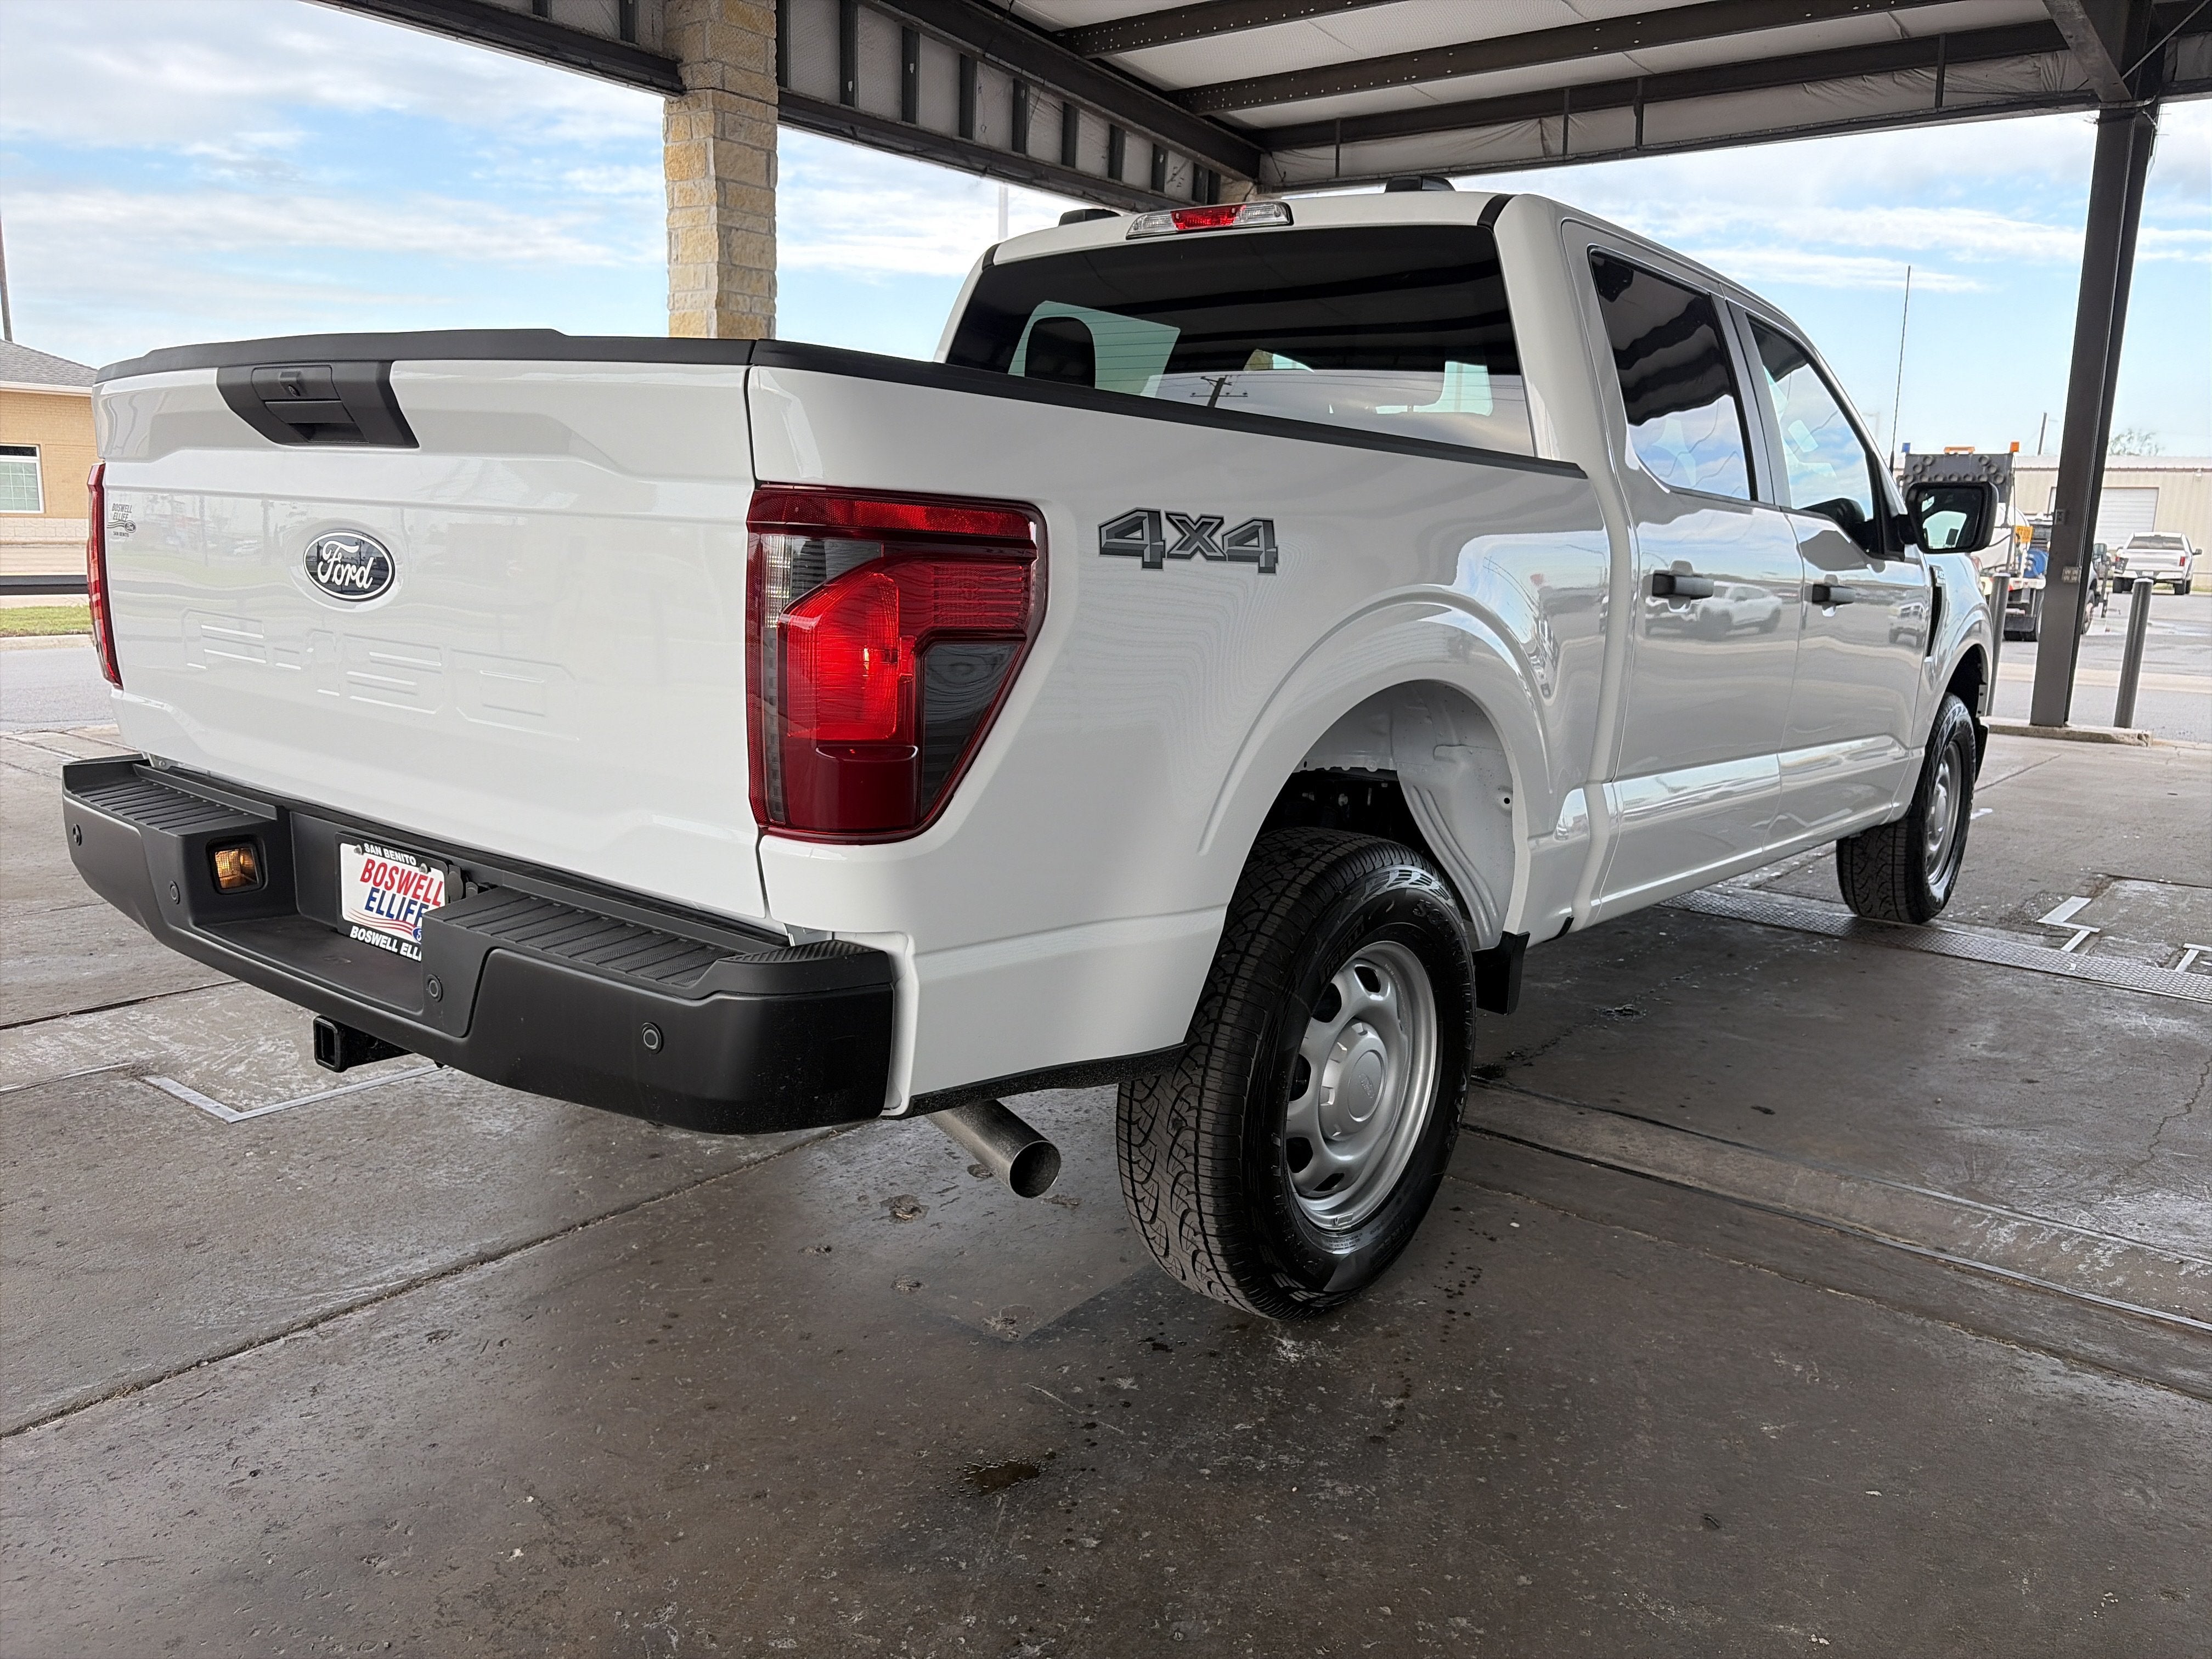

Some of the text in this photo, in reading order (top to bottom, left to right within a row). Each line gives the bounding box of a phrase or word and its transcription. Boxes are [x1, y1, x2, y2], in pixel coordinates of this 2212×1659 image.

[111, 503, 132, 513] BOSWELL
[317, 540, 375, 589] Ford
[364, 843, 417, 866] SAN BENITO
[359, 858, 444, 906] BOSWELL
[364, 886, 430, 927] ELLIFF
[349, 926, 398, 953] BOSWELL
